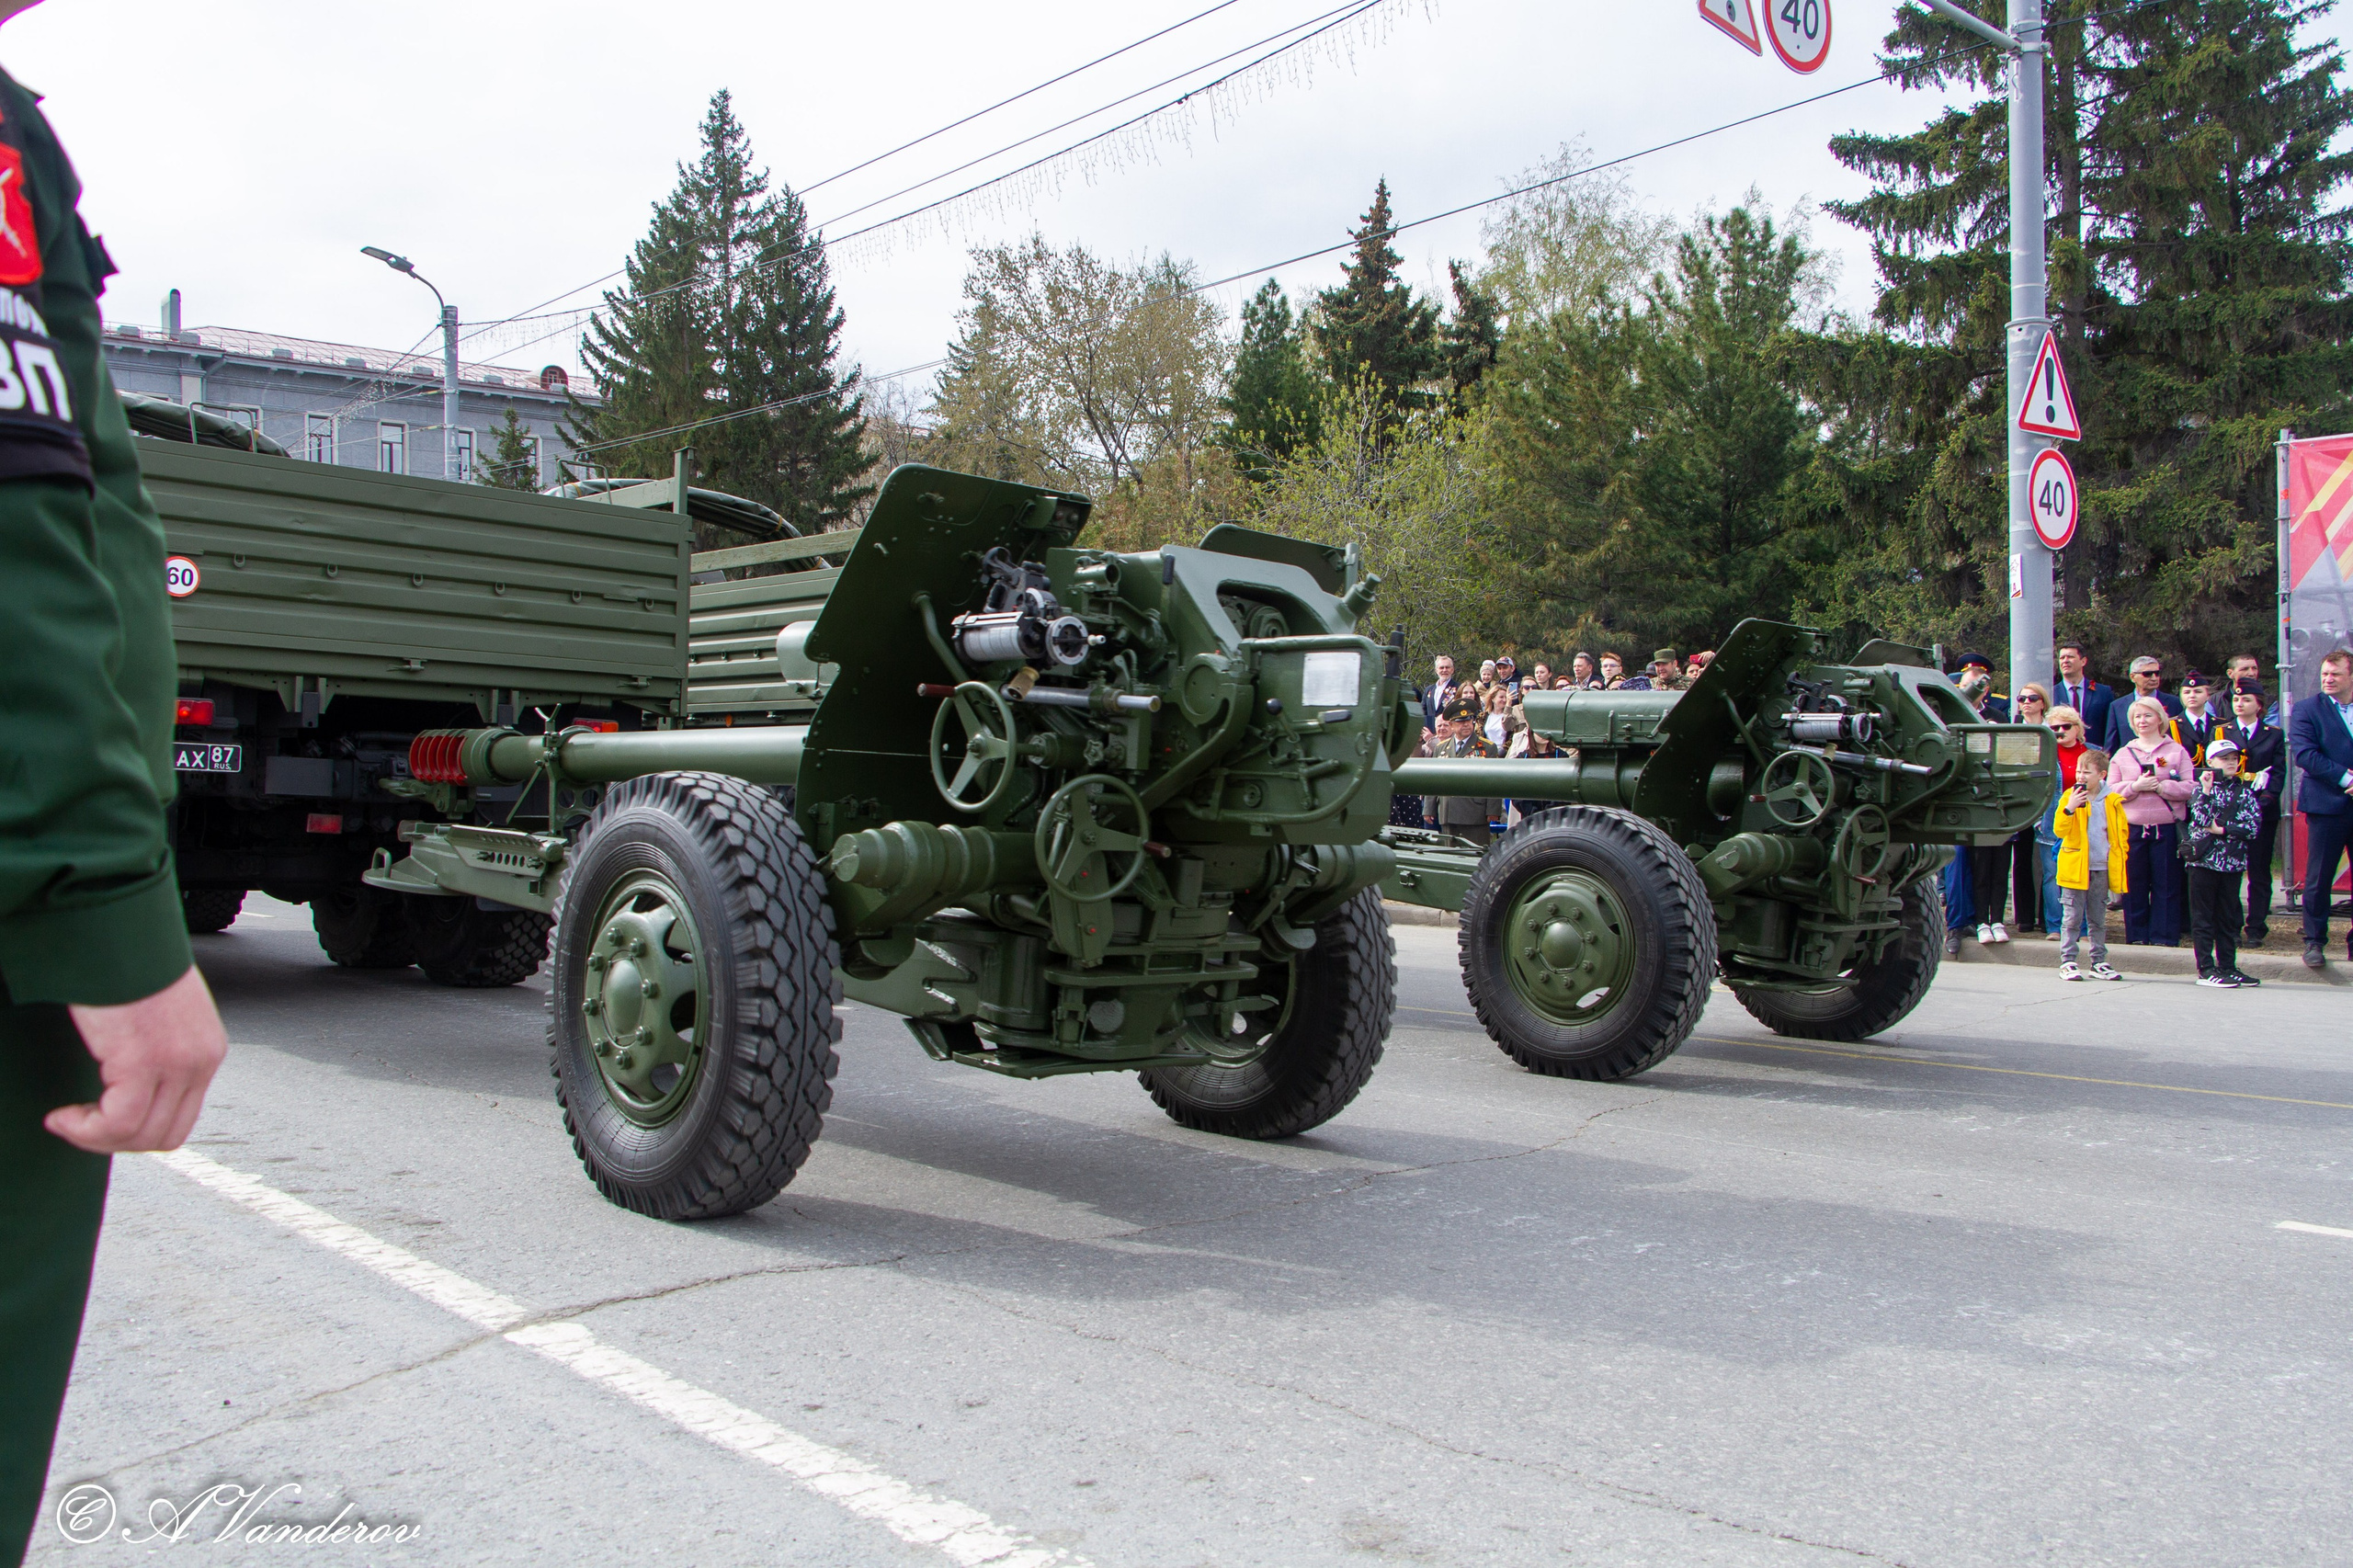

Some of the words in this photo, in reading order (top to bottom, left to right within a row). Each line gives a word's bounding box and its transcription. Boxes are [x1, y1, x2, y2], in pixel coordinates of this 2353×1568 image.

[1780, 0, 1819, 40] 40
[2039, 480, 2064, 517] 40
[167, 566, 194, 586] 60
[211, 746, 234, 764] 87
